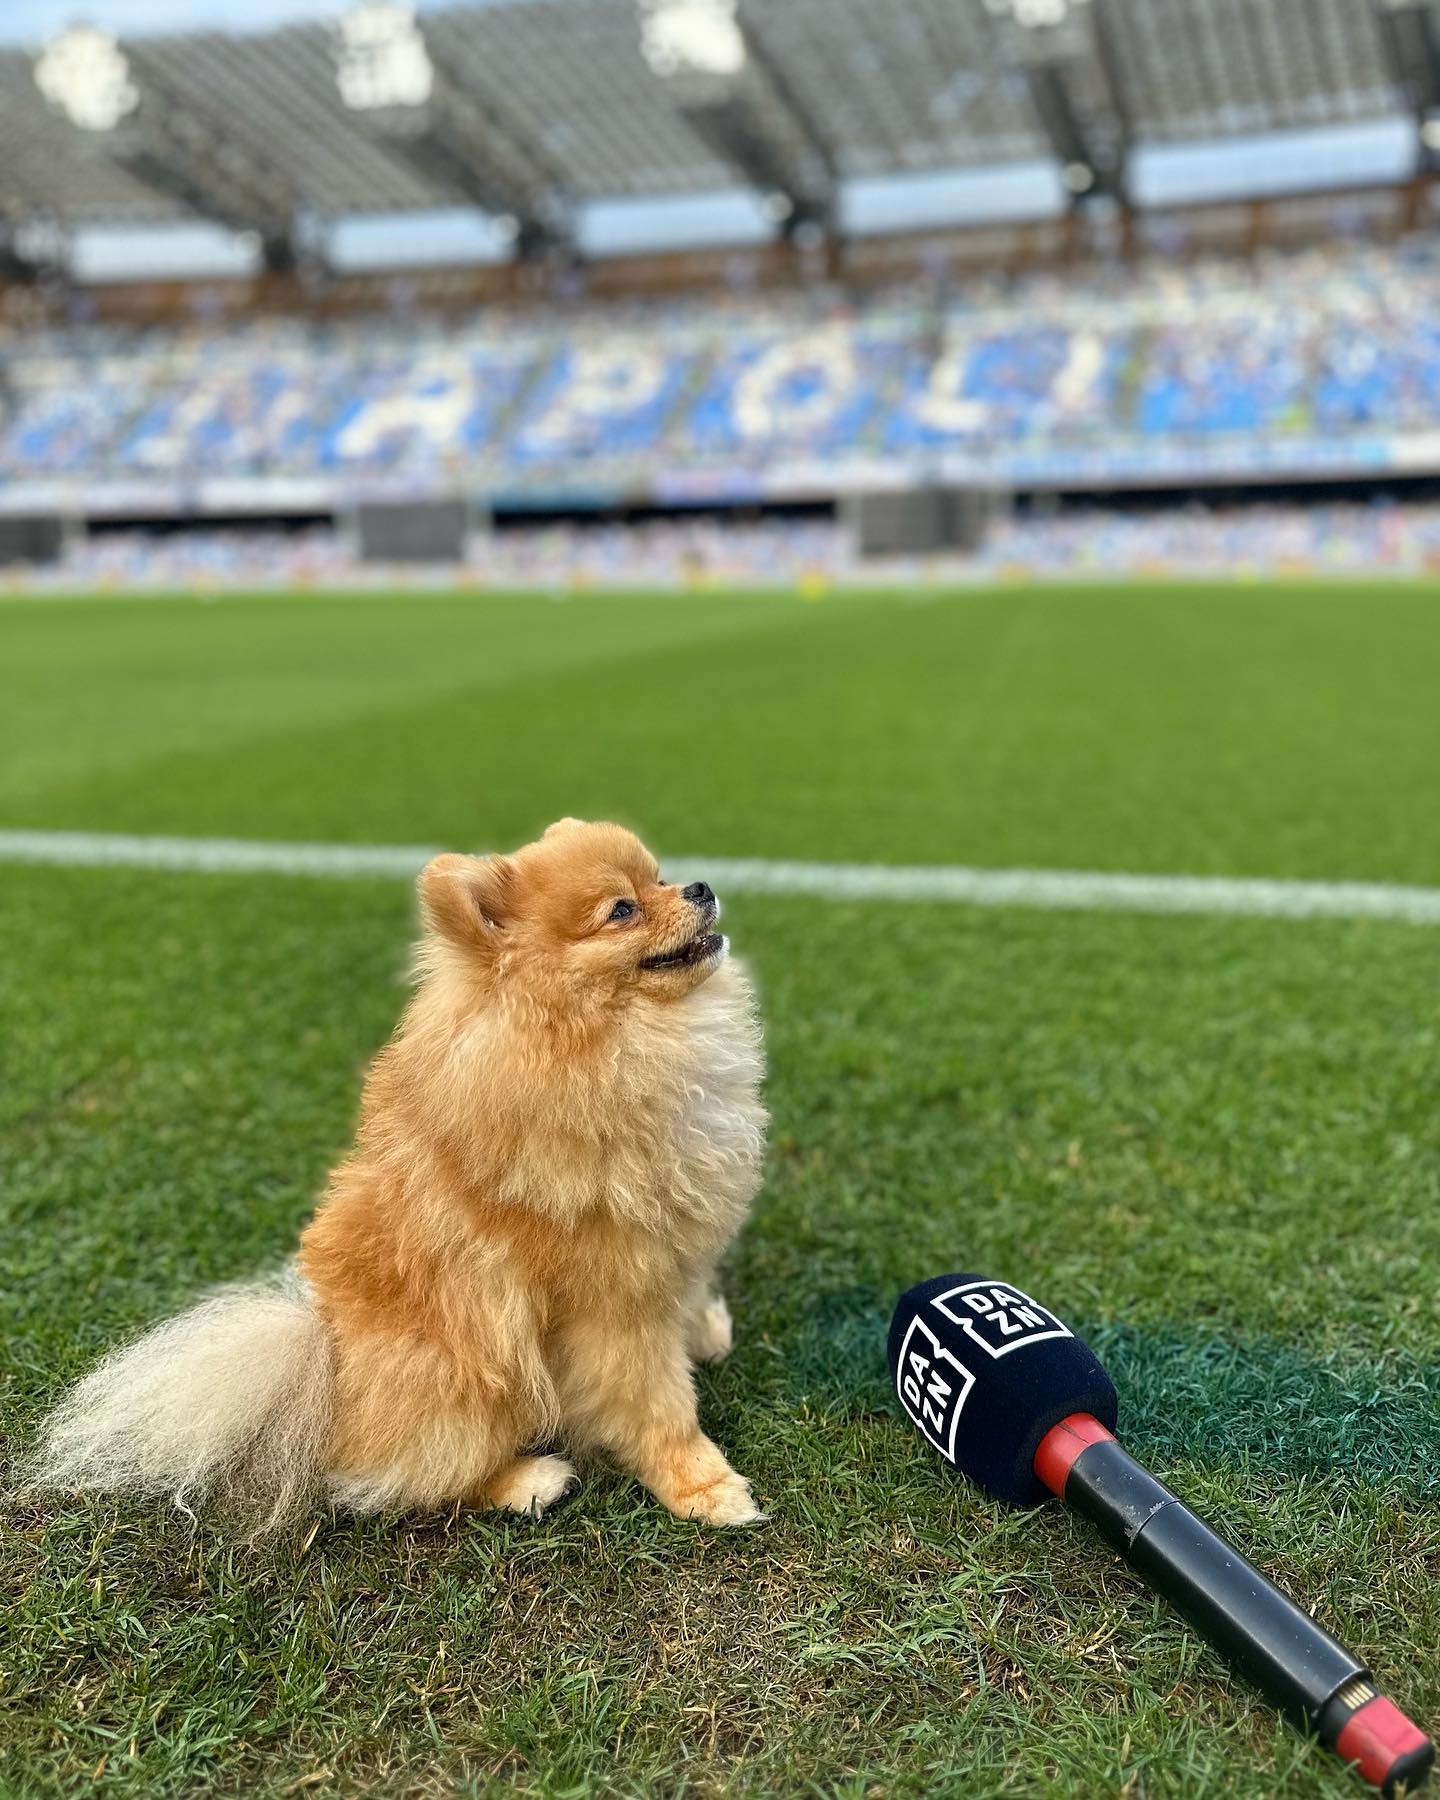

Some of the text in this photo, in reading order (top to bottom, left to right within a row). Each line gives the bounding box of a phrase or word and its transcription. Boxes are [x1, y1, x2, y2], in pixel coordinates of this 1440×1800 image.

[961, 1288, 1022, 1314] DA
[986, 1305, 1046, 1336] ZN
[904, 1351, 930, 1408] DA
[922, 1370, 952, 1434] ZN
